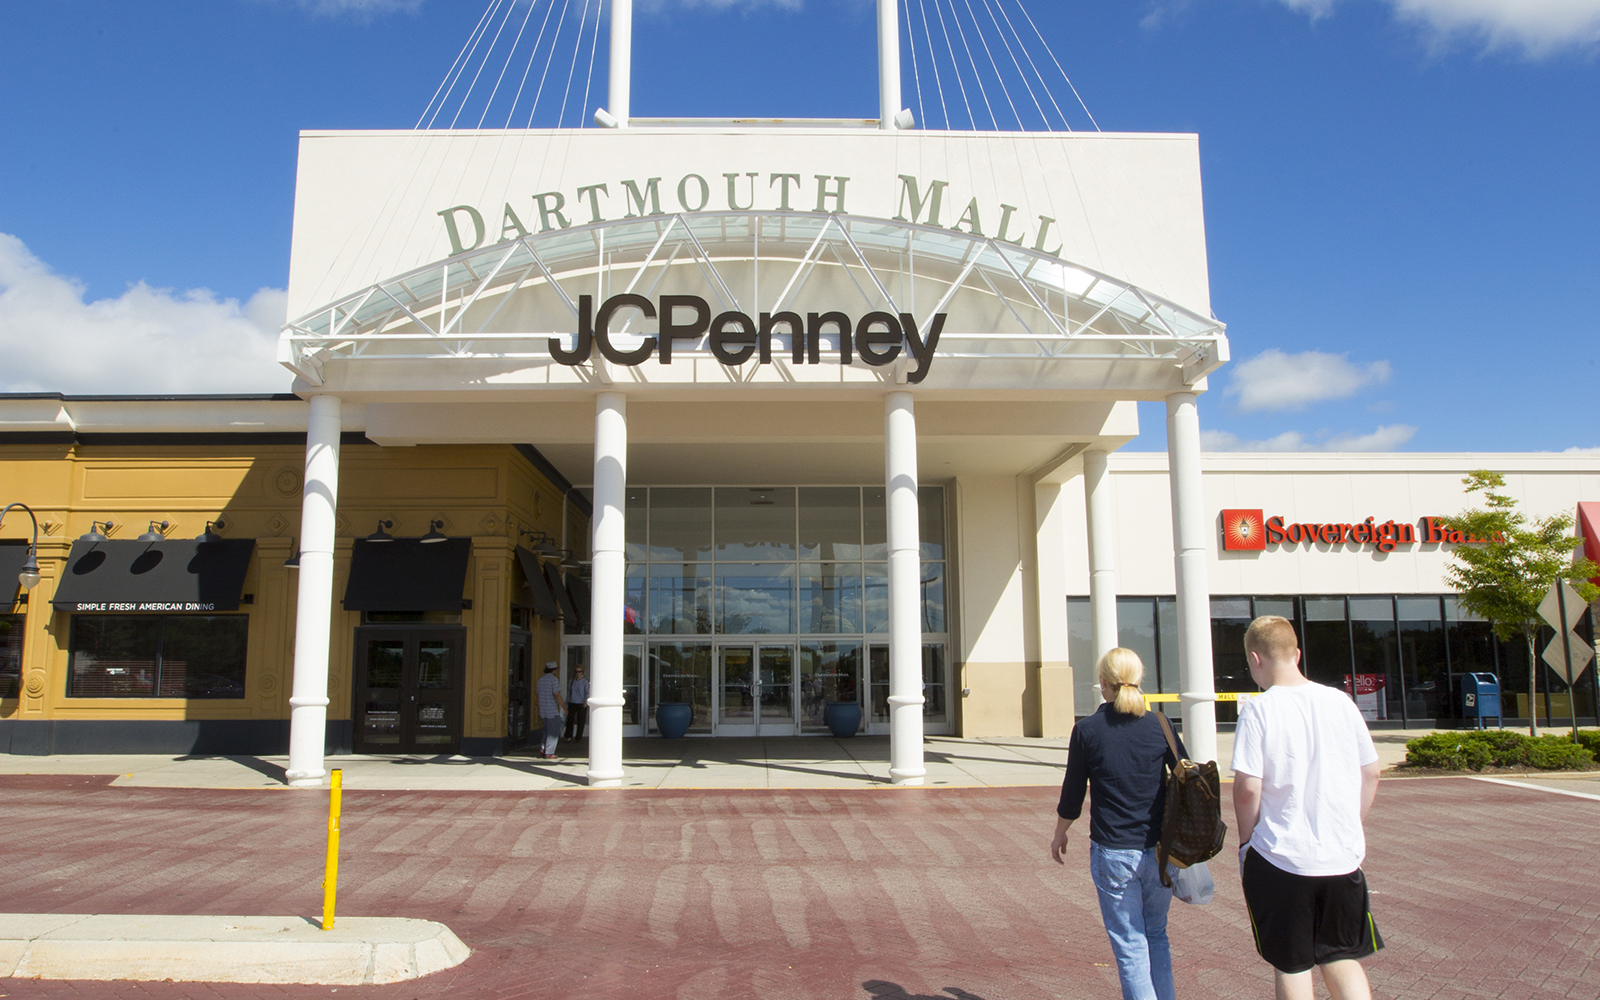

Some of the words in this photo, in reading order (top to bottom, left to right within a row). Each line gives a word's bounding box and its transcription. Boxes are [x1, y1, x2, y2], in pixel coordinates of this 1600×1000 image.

[436, 172, 850, 257] DARTMOUTH
[892, 174, 1063, 257] MALL
[547, 293, 948, 384] JCPenney
[1266, 515, 1418, 552] Sovereign
[76, 603, 106, 611] SIMPLE
[108, 603, 136, 611] FRESH
[138, 603, 183, 611] AMERICAN
[185, 603, 215, 611] DINING
